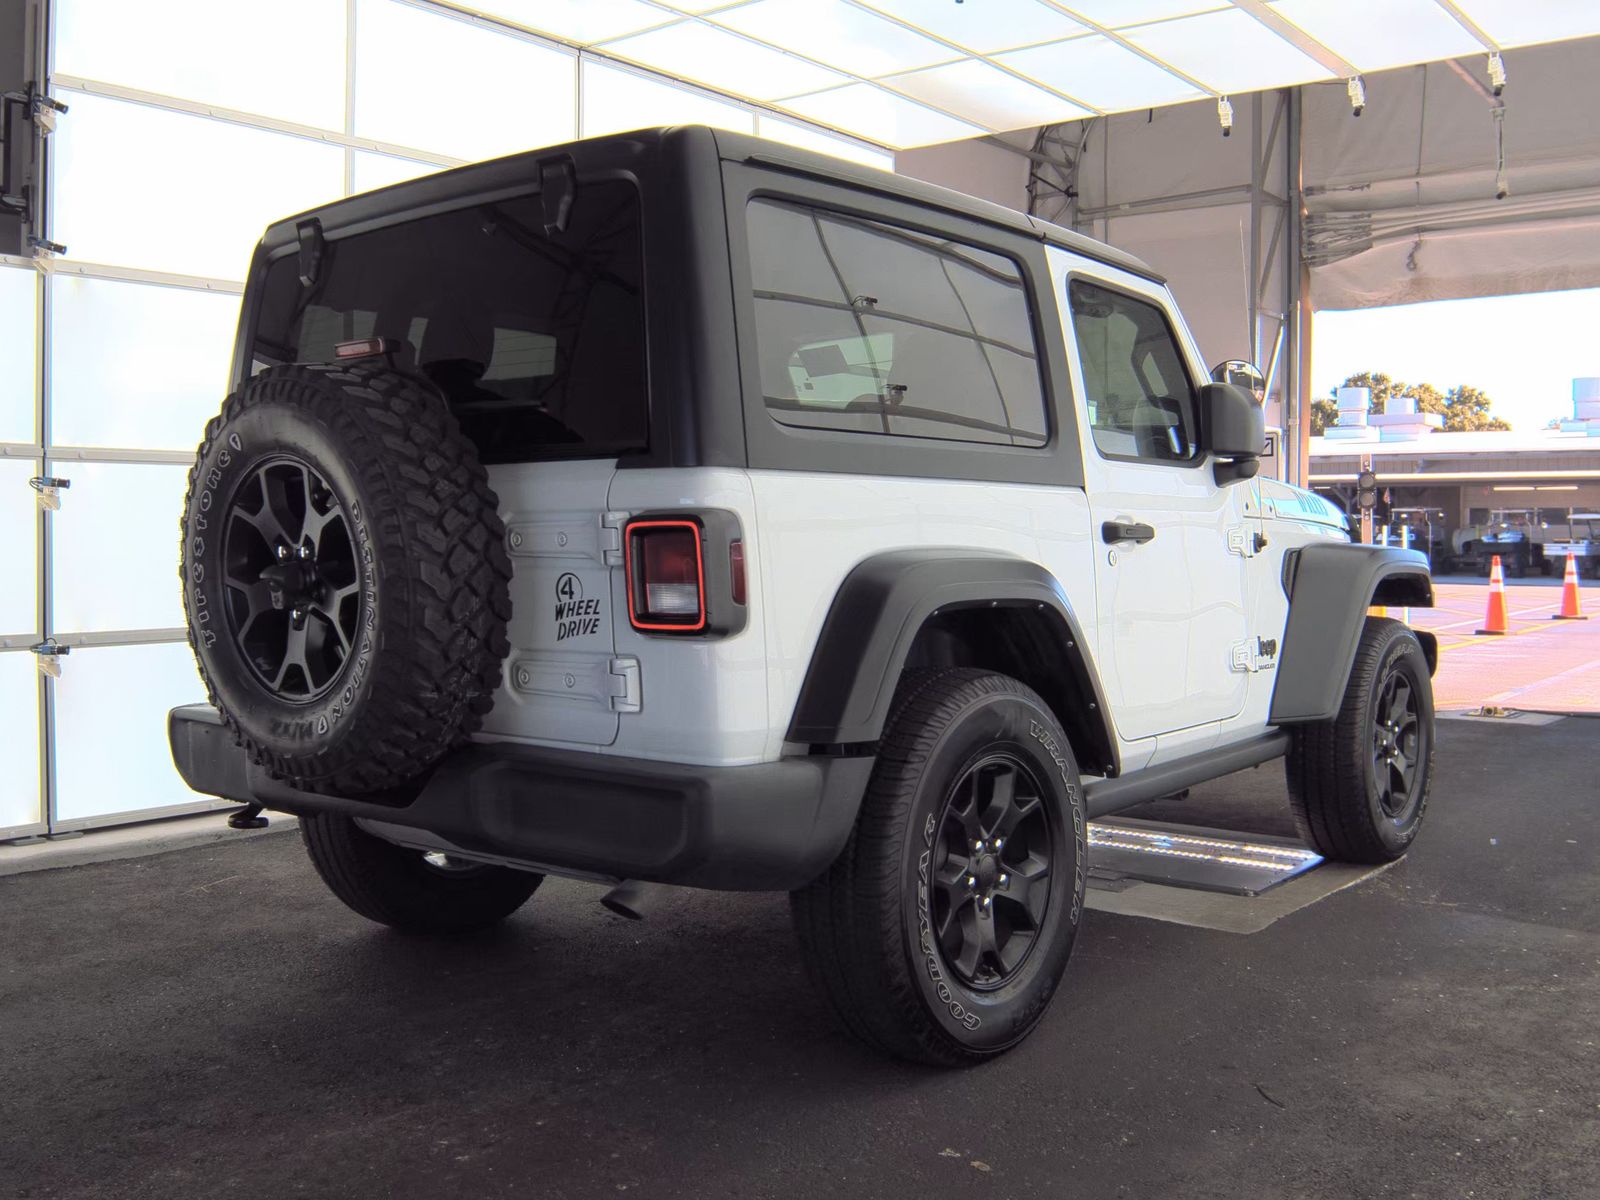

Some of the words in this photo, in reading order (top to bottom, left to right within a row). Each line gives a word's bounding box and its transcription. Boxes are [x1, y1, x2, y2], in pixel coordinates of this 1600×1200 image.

[193, 449, 231, 649] Firestone
[560, 576, 575, 600] 4
[332, 500, 377, 724] DESTINATION
[555, 599, 600, 622] WHEEL
[556, 618, 600, 642] DRIVE
[1257, 635, 1277, 660] Jeep
[1030, 718, 1085, 926] WRANGLER
[918, 812, 982, 1031] GOODYEAR
